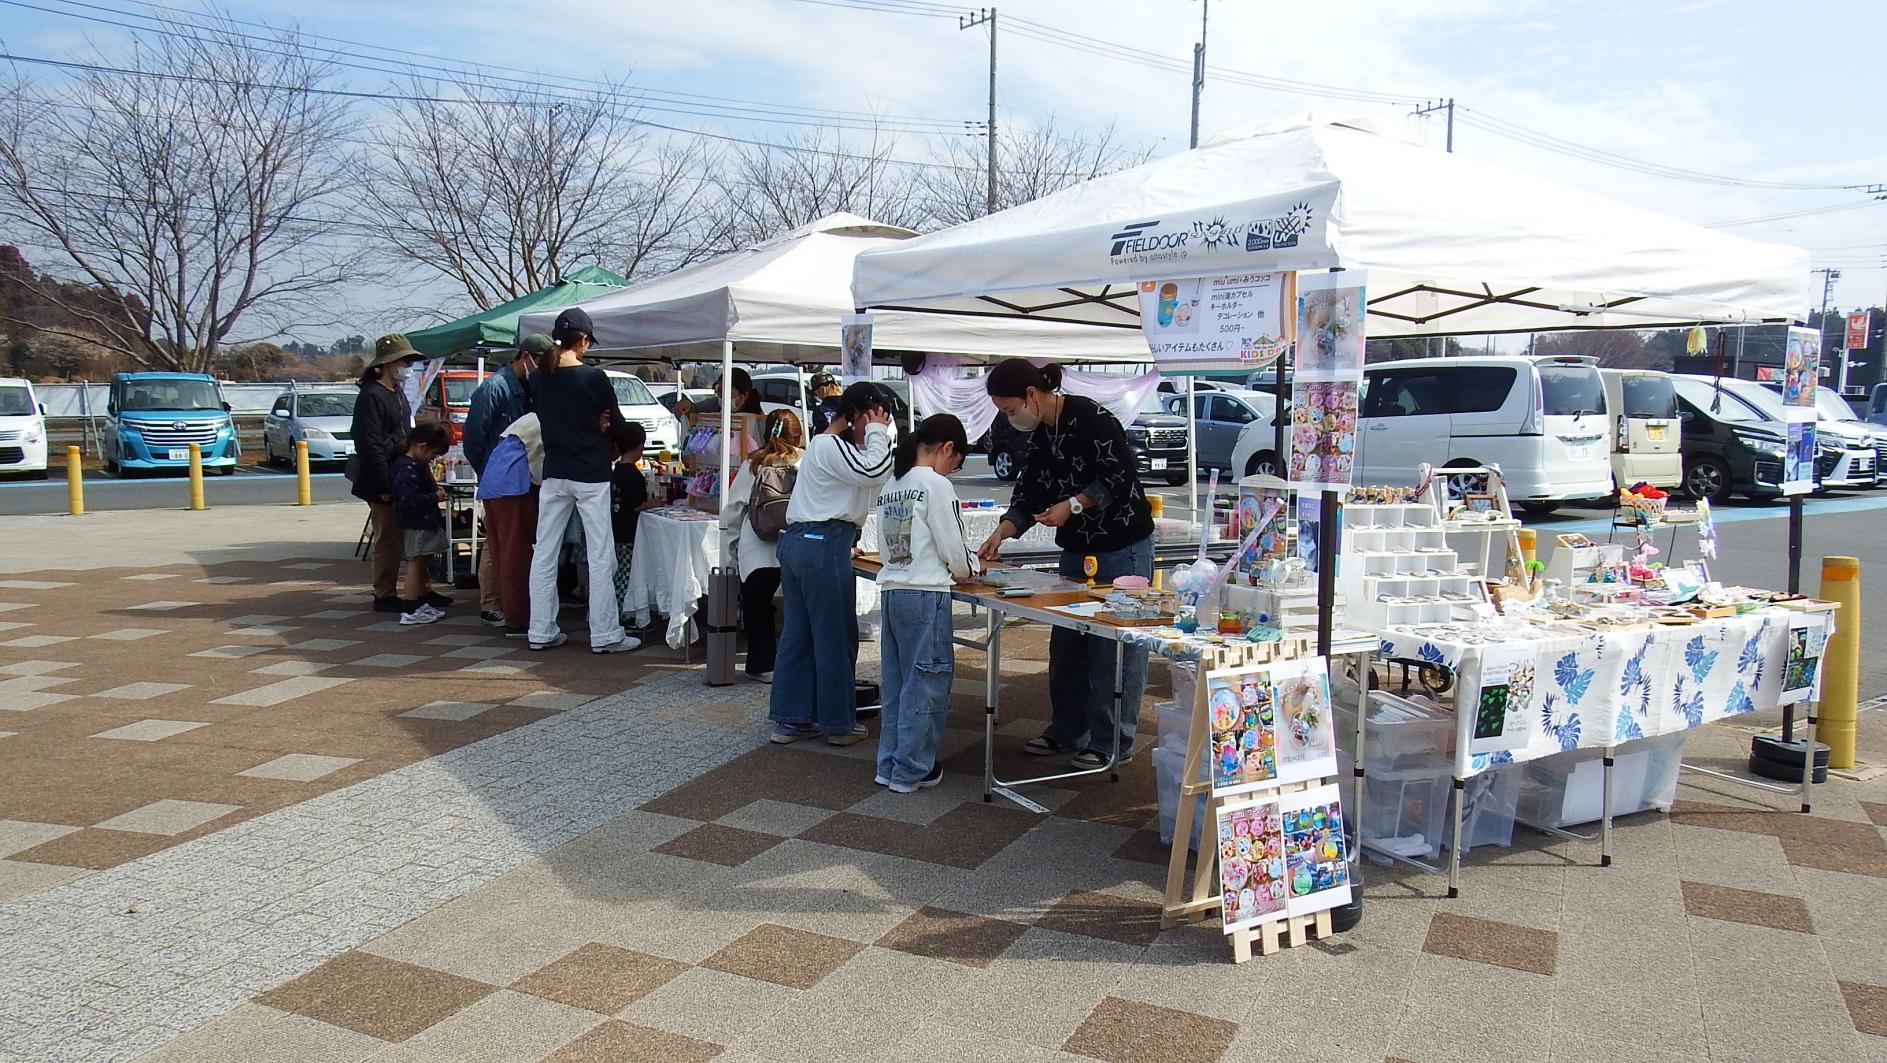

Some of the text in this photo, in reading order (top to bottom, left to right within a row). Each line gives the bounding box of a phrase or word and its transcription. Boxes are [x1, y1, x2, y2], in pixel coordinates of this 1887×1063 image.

[1125, 231, 1189, 254] FIELDOOR
[1110, 255, 1138, 266] Powered
[1140, 255, 1148, 265] by
[1209, 301, 1243, 311] キーホルダー
[1240, 350, 1264, 359] KIDS
